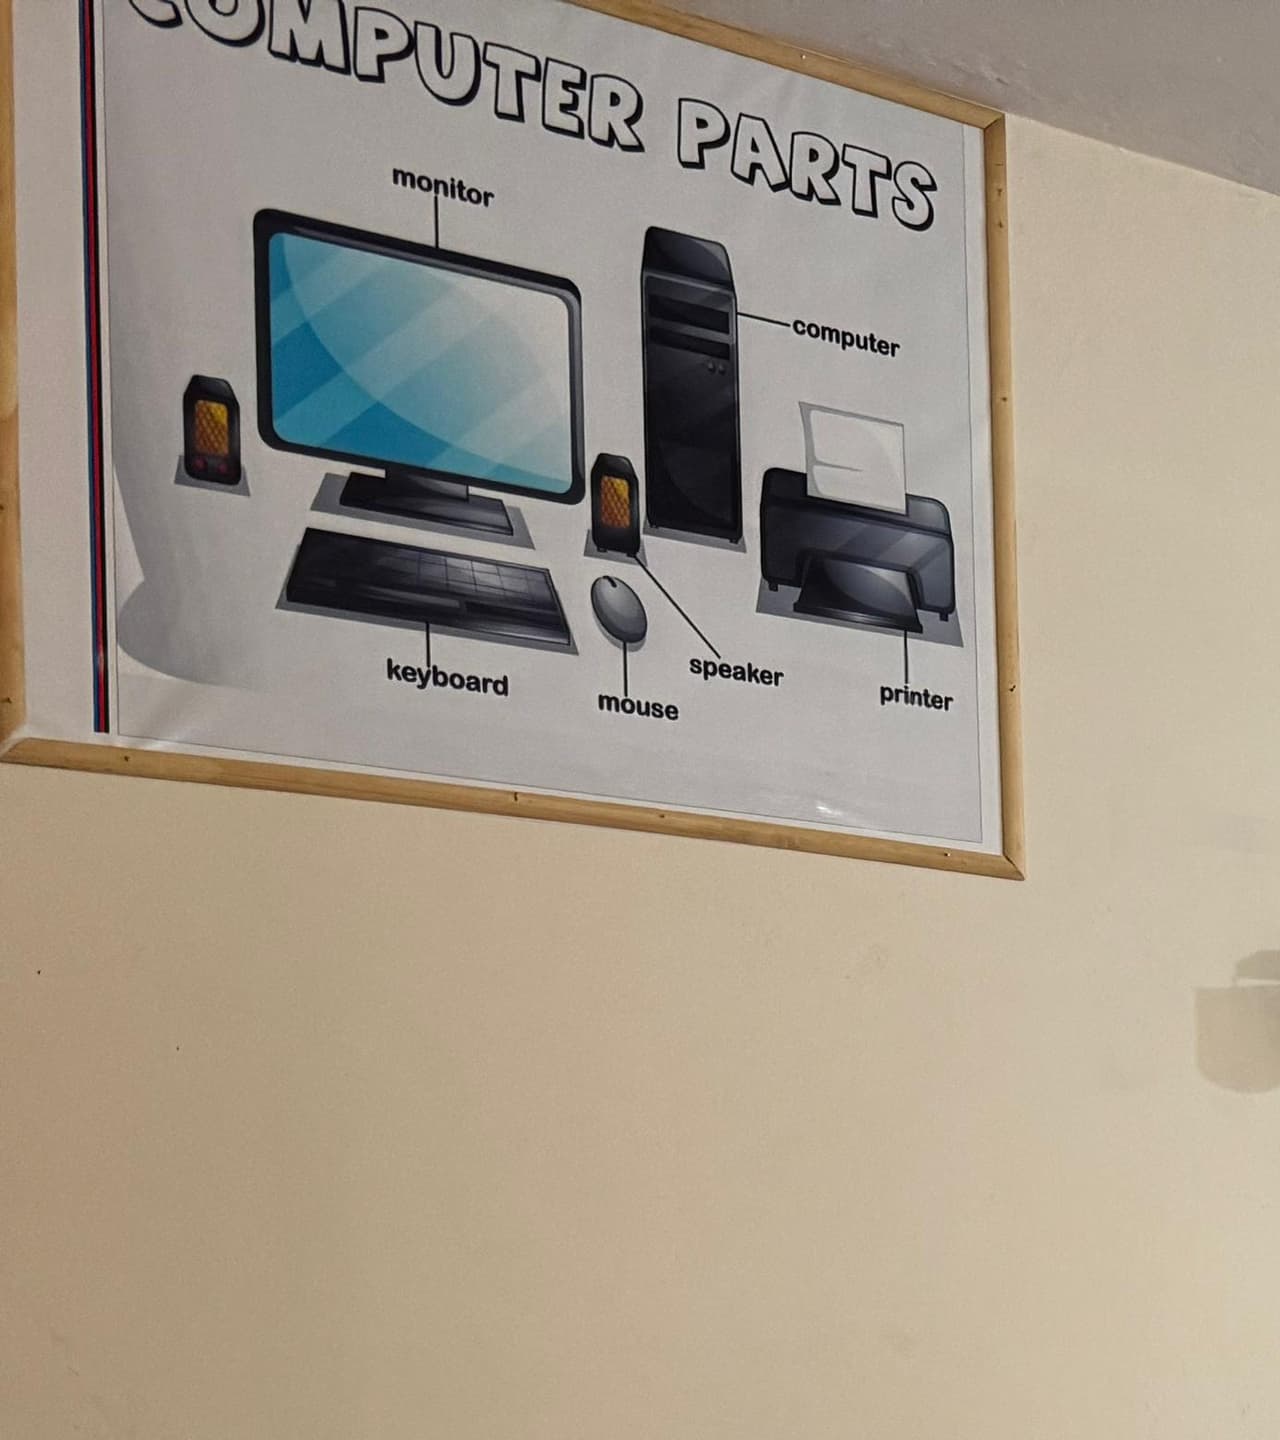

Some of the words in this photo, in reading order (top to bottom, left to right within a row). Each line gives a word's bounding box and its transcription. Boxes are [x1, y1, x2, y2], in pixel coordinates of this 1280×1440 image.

[677, 98, 938, 232] PARTS
[392, 166, 495, 207] monitor
[792, 317, 901, 358] computer
[386, 657, 510, 697] keyboard
[689, 655, 785, 687] speaker
[598, 690, 680, 722] mouse
[879, 682, 954, 712] printer
